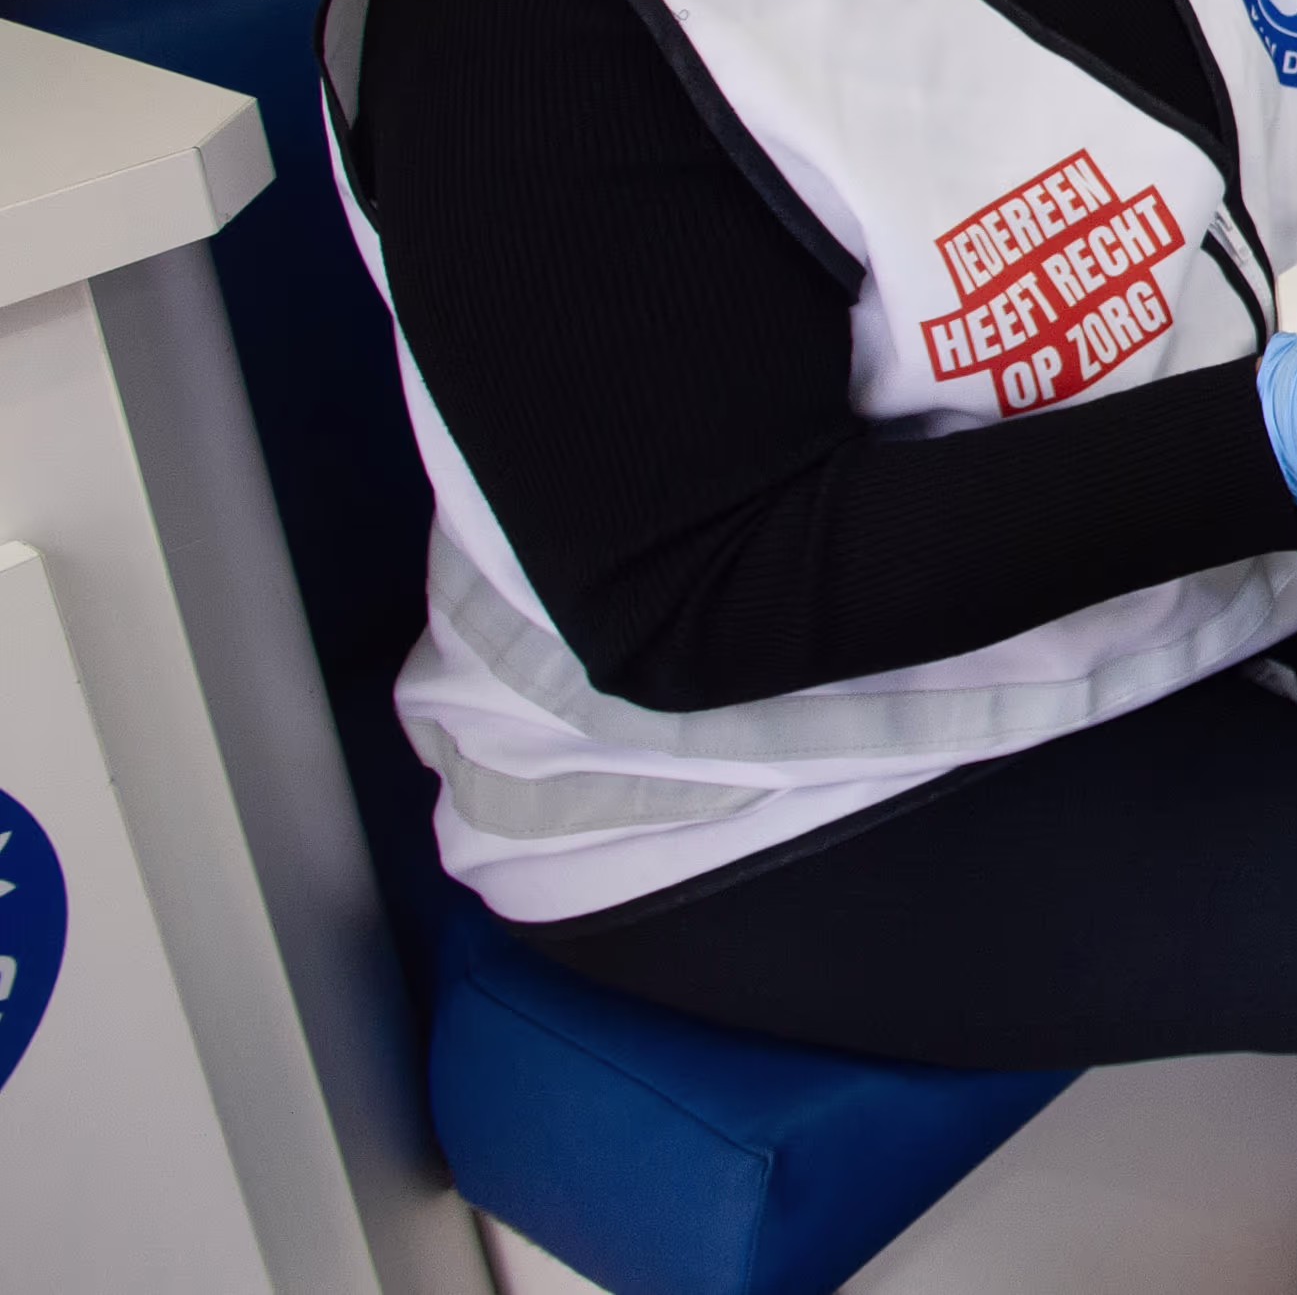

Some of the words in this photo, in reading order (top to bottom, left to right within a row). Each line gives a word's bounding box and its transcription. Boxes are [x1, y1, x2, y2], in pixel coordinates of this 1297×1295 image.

[931, 272, 1059, 373] HEEFT
[1041, 194, 1172, 307] RECHT
[945, 157, 1111, 295] IEDEREEN
[1002, 345, 1062, 409] OP
[1066, 280, 1168, 382] ZORG
